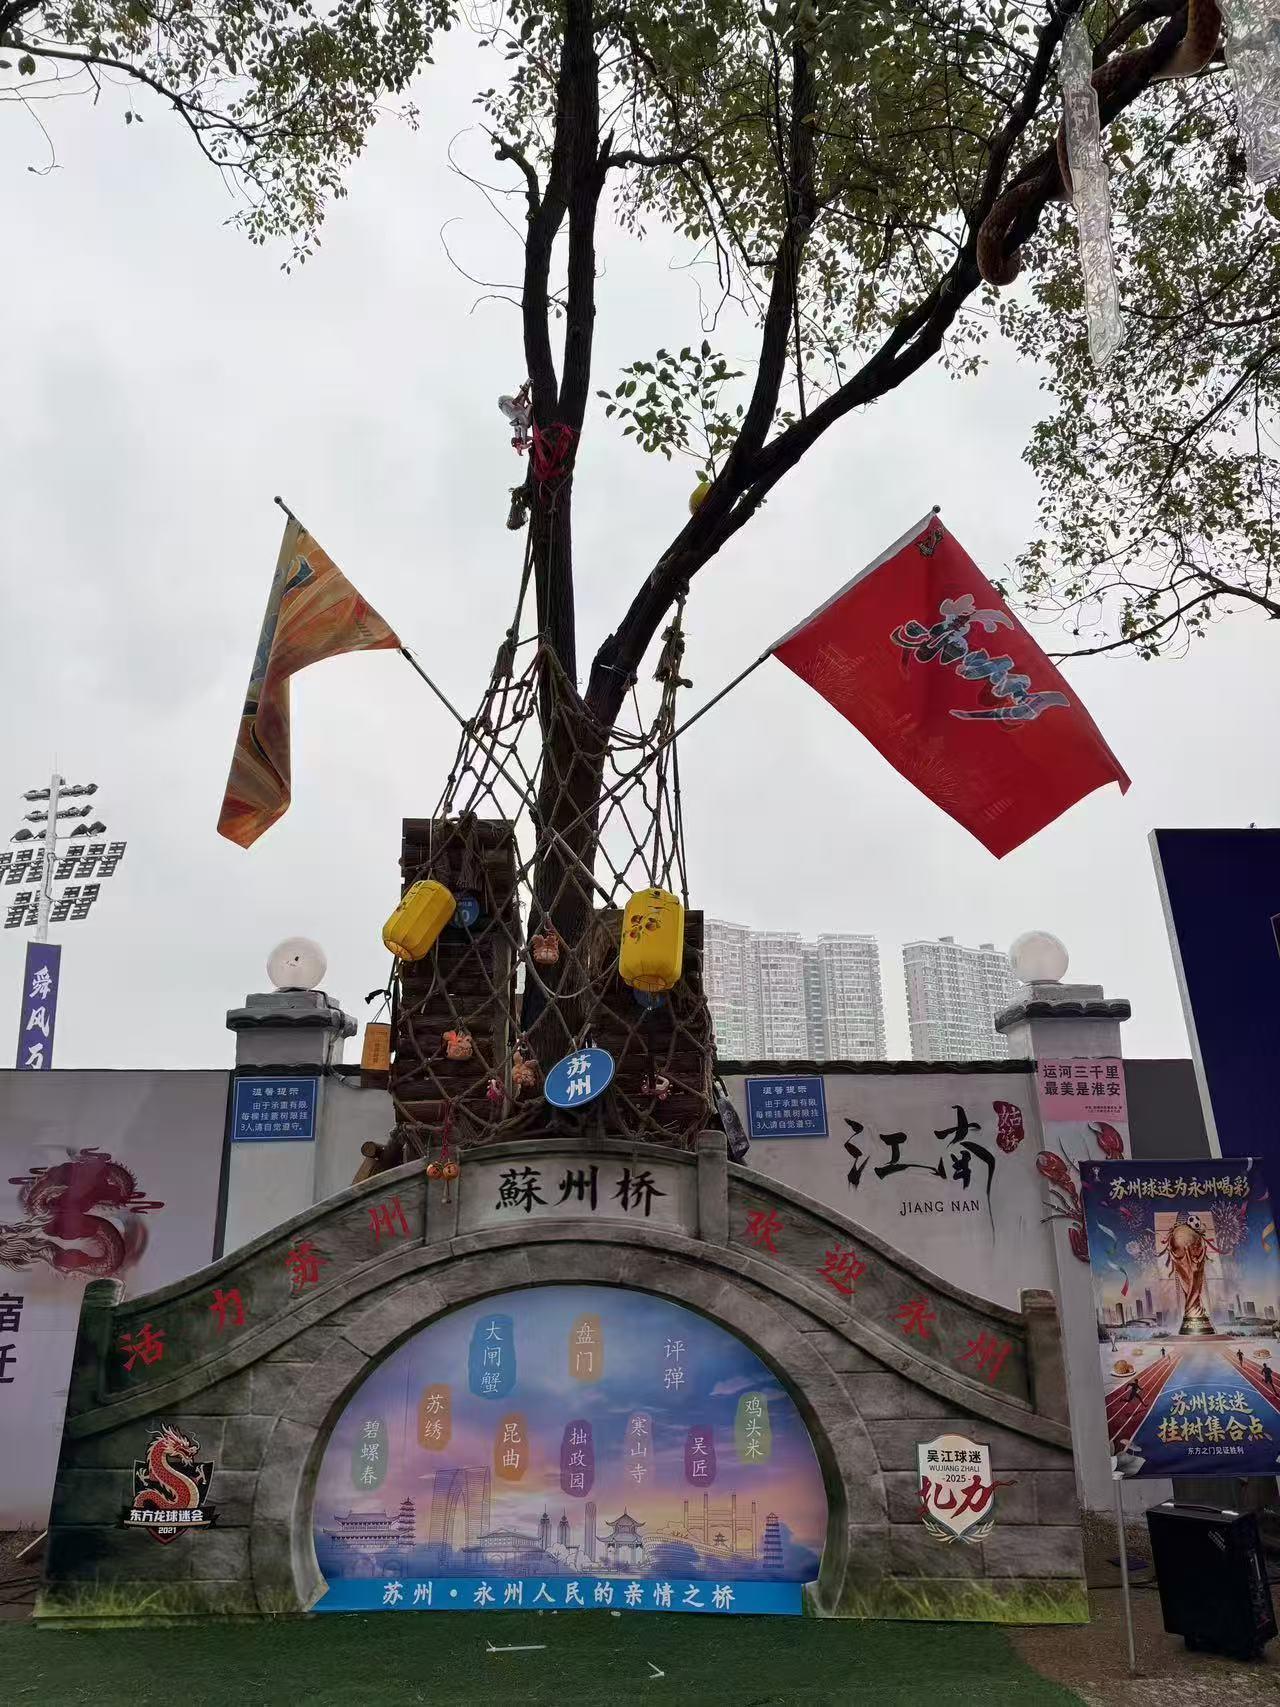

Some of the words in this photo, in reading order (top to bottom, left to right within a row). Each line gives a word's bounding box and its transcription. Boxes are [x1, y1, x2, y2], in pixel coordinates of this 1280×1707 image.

[566, 1054, 591, 1102] 苏州
[1043, 1065, 1120, 1080] 运河三千里
[1044, 1081, 1121, 1097] 最美是淮安
[844, 1105, 996, 1220] 江南
[495, 1165, 668, 1217] 蘇州桥
[900, 1201, 944, 1216] JIANG
[951, 1200, 981, 1212] NAN
[1109, 1176, 1251, 1200] 苏州球迷为永州喝彩
[481, 1320, 503, 1394] 大闸蟹
[576, 1322, 595, 1373] 盘门
[664, 1338, 686, 1391] 评弹
[424, 1394, 445, 1440] 苏绣
[1170, 1390, 1254, 1415] 苏州球迷
[502, 1422, 521, 1469] 昆曲
[629, 1416, 649, 1484] 寒山寺
[745, 1396, 764, 1459] 鸡头米
[1157, 1415, 1272, 1443] 挂树集合点
[1187, 1446, 1245, 1455] 东方之门见证胜利
[360, 1420, 380, 1485] 碧螺春
[568, 1427, 587, 1489] 拙政园
[691, 1437, 708, 1478] 吴匠
[927, 1449, 982, 1463] 吴江球迷
[130, 1509, 204, 1522] 东方龙球迷会
